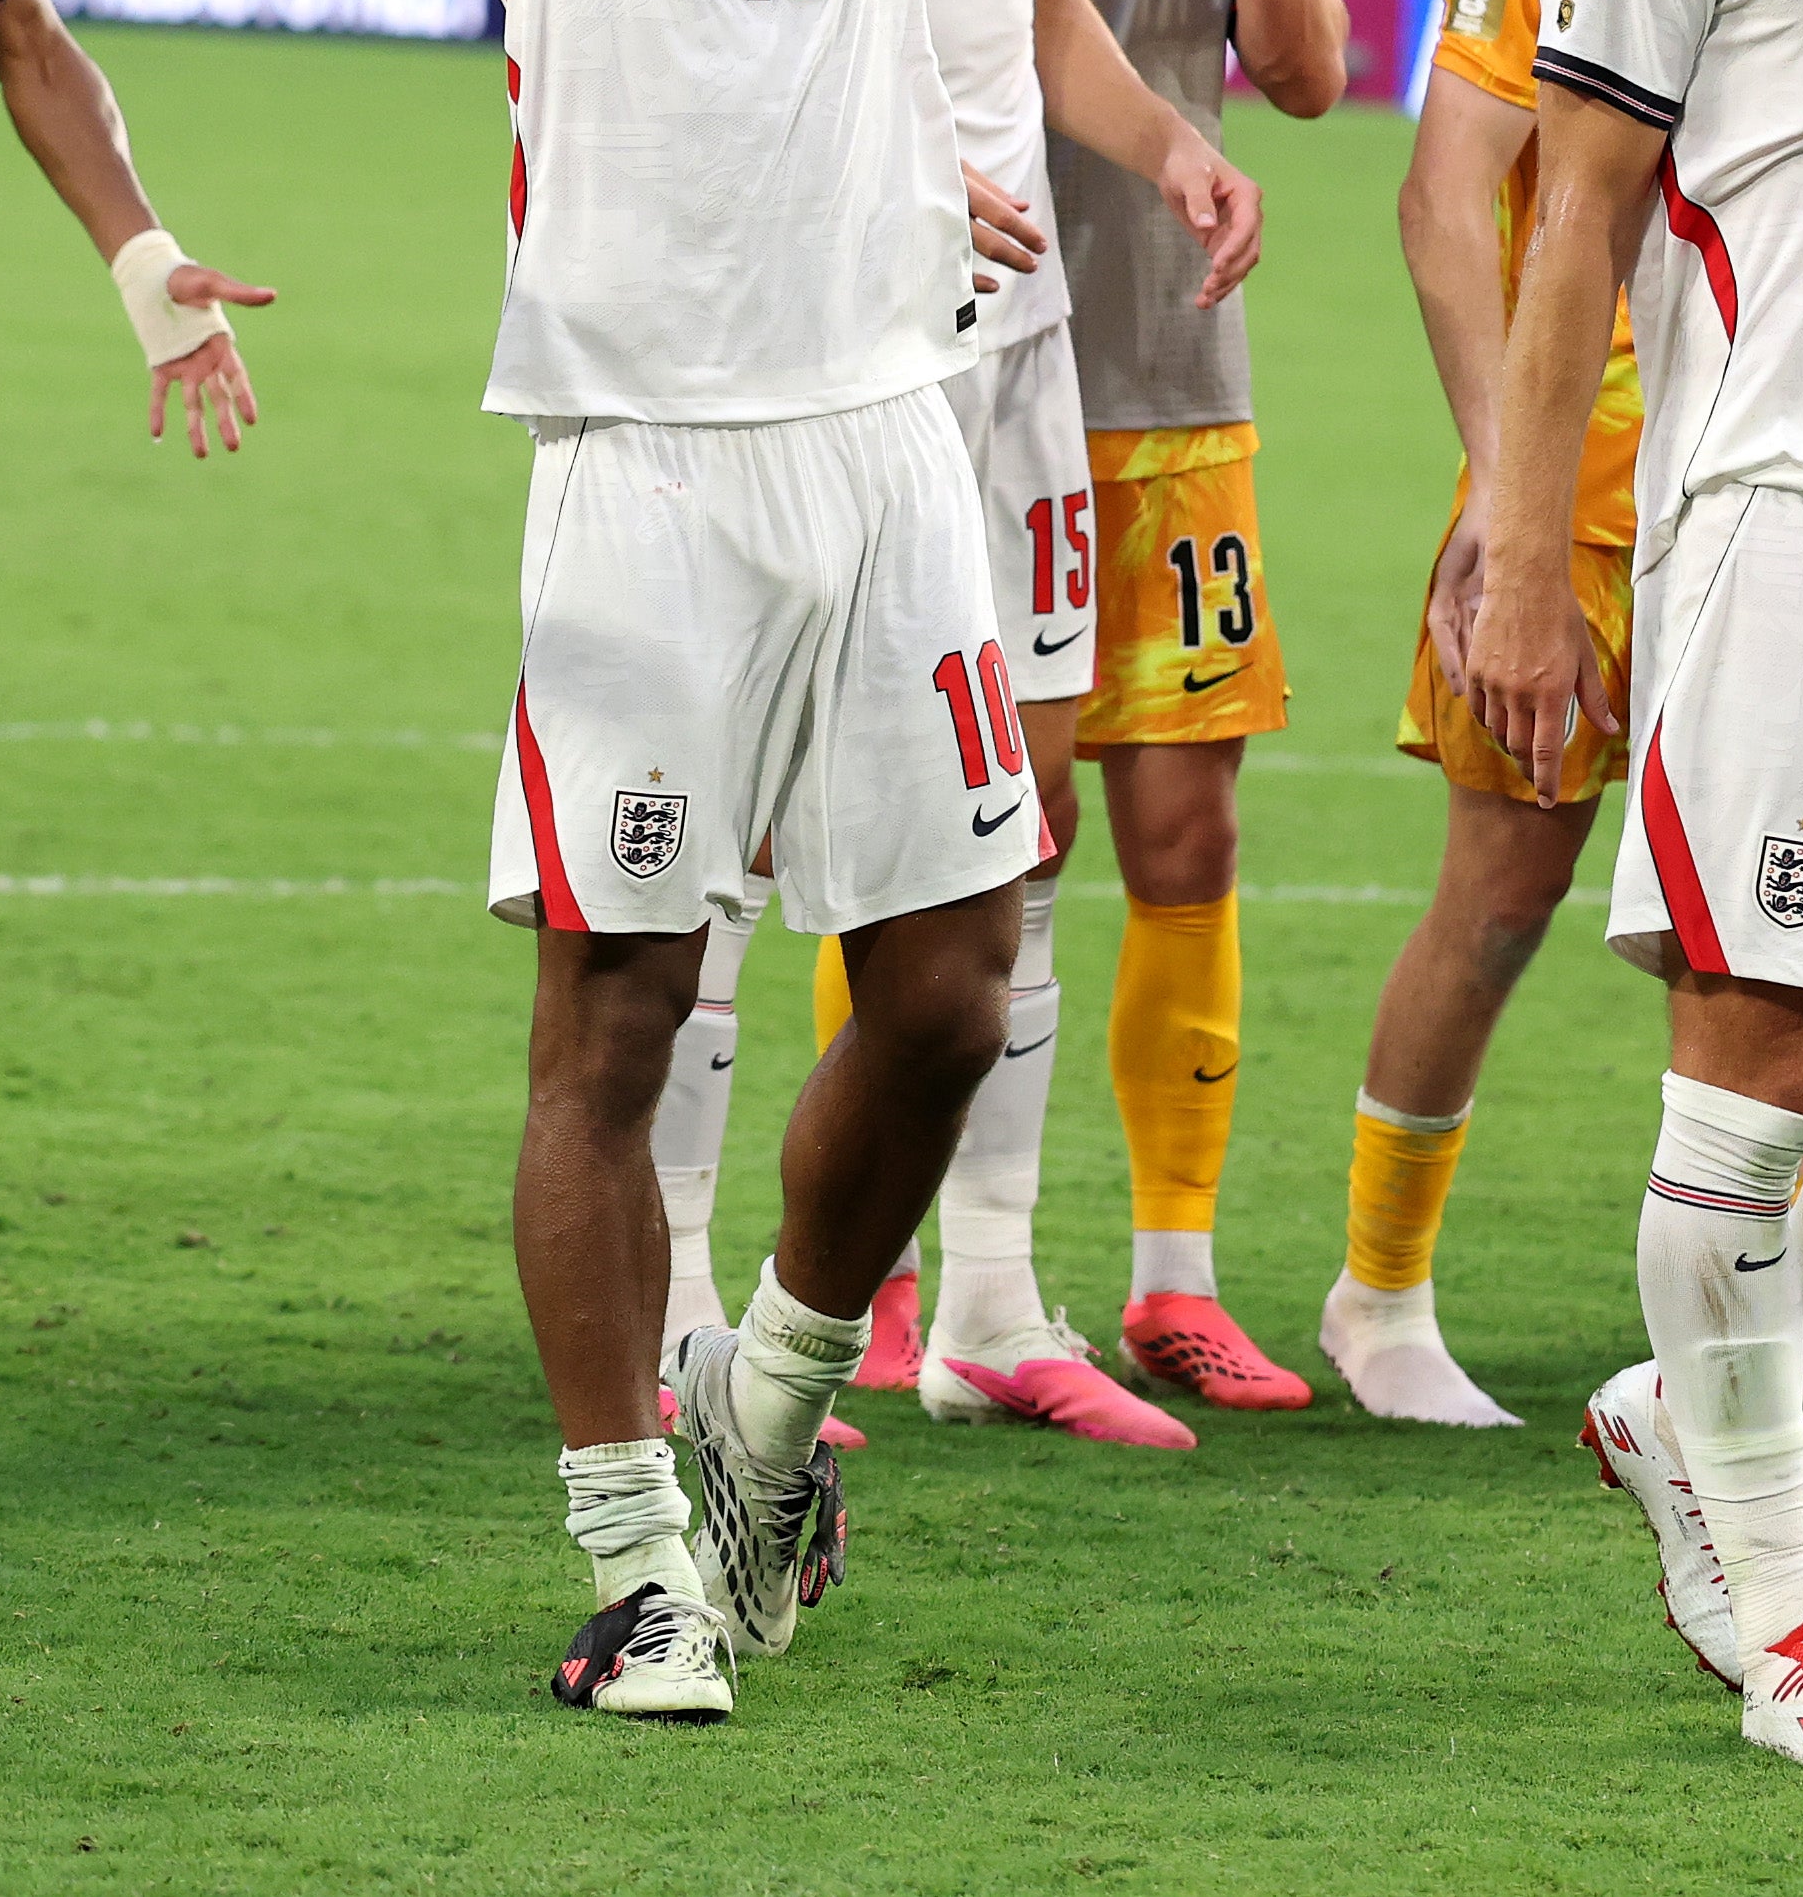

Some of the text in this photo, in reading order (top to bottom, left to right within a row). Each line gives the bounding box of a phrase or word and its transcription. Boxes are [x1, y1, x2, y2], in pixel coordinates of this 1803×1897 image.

[1025, 489, 1091, 616] 15
[1167, 531, 1257, 650] 13
[931, 637, 1026, 791] 10
